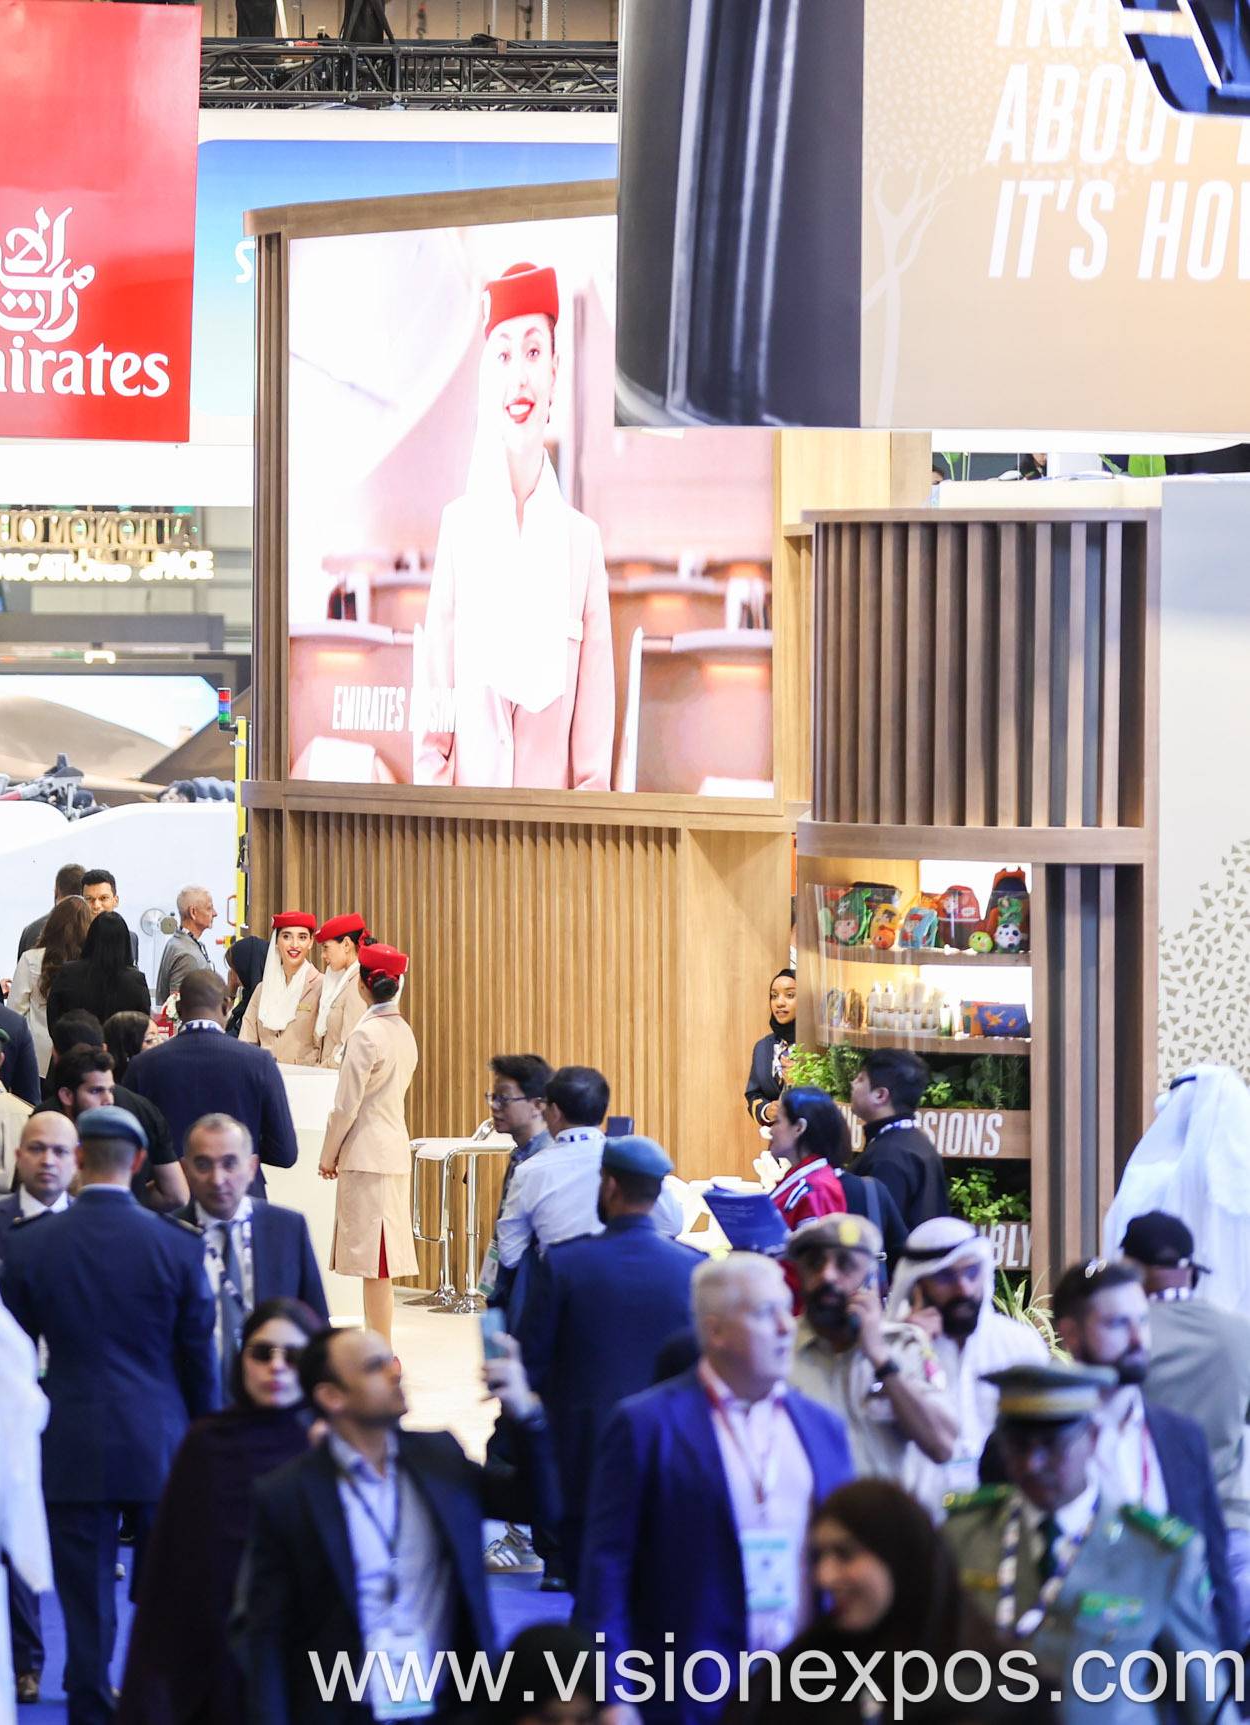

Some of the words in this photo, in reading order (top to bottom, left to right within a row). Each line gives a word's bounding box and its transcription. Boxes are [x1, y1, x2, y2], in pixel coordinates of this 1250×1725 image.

[988, 179, 1116, 281] IT'S
[1137, 180, 1250, 281] HO
[332, 685, 406, 732] EMIRATES
[914, 1111, 1003, 1156] SIONS
